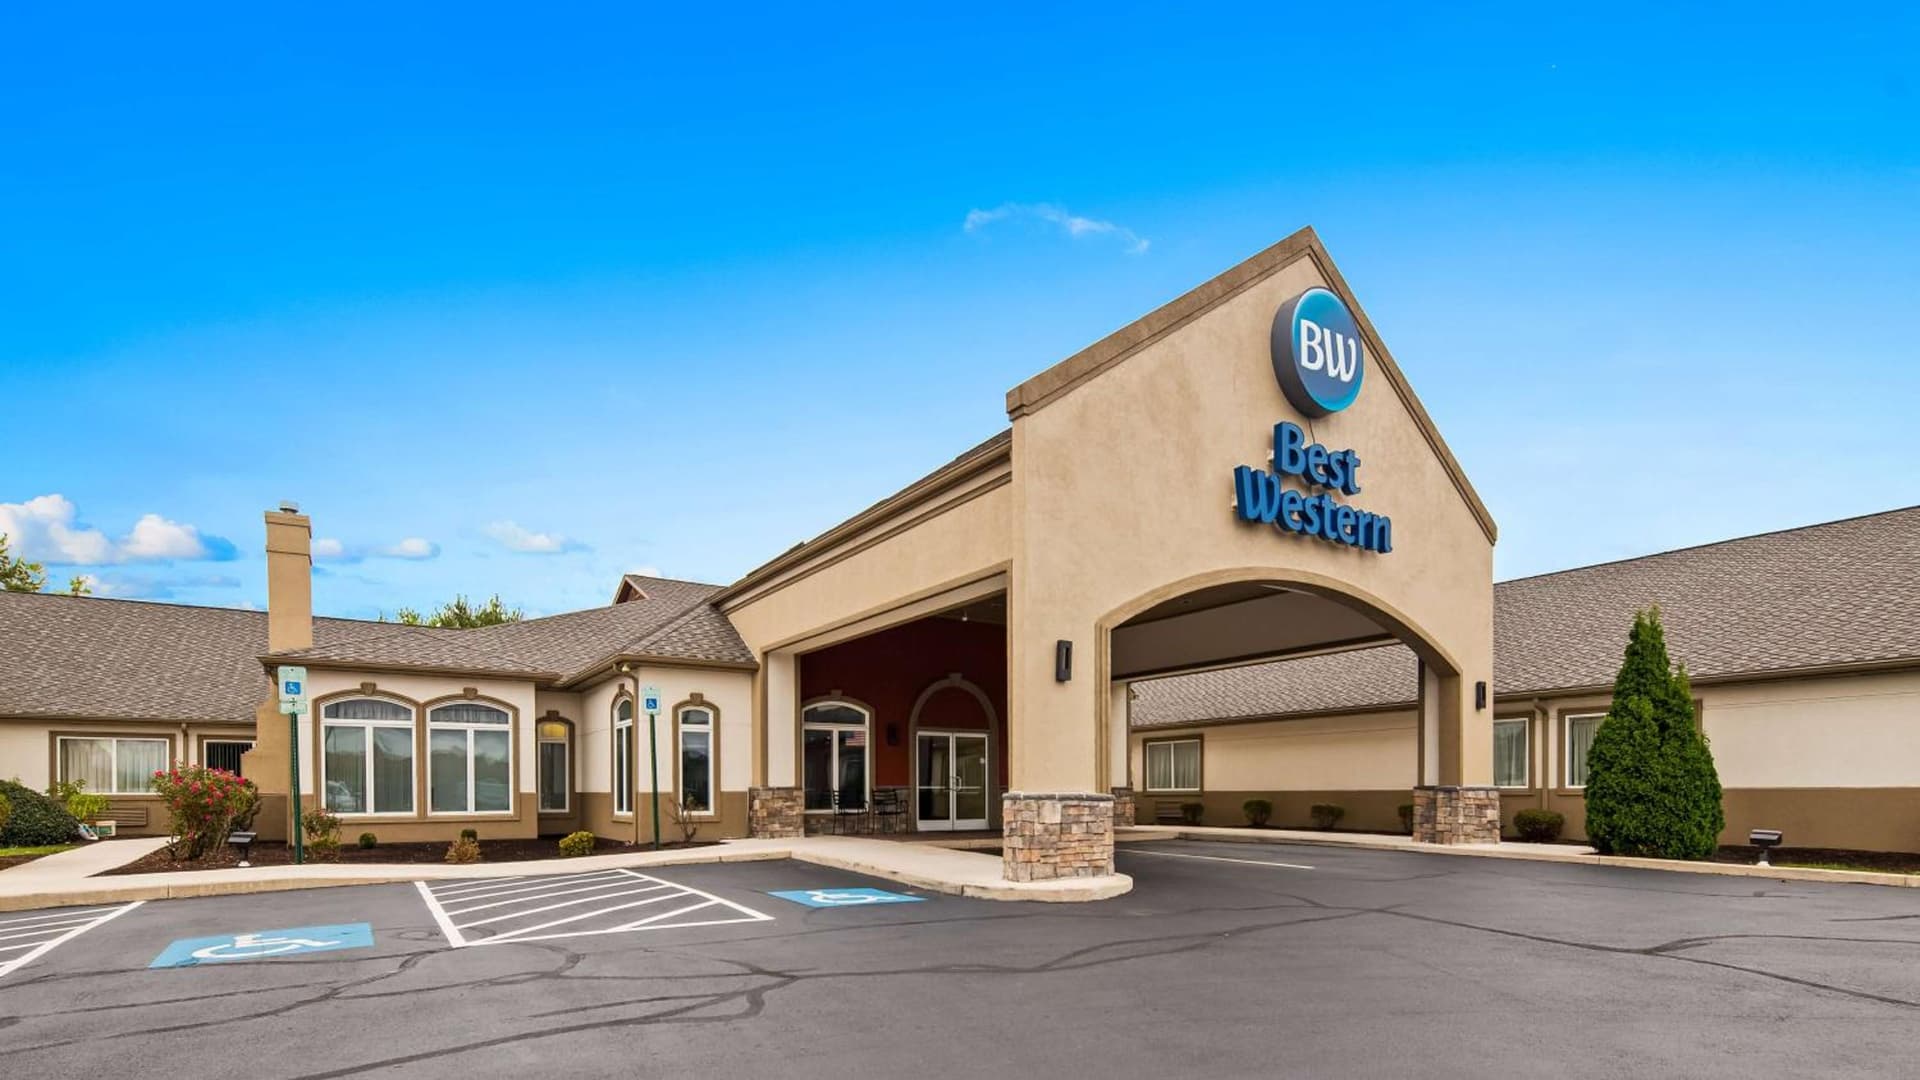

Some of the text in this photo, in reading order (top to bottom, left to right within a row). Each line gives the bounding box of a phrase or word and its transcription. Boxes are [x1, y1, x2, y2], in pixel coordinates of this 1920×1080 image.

[1301, 319, 1357, 382] BW
[1274, 421, 1361, 495] Best
[1234, 465, 1392, 553] Western
